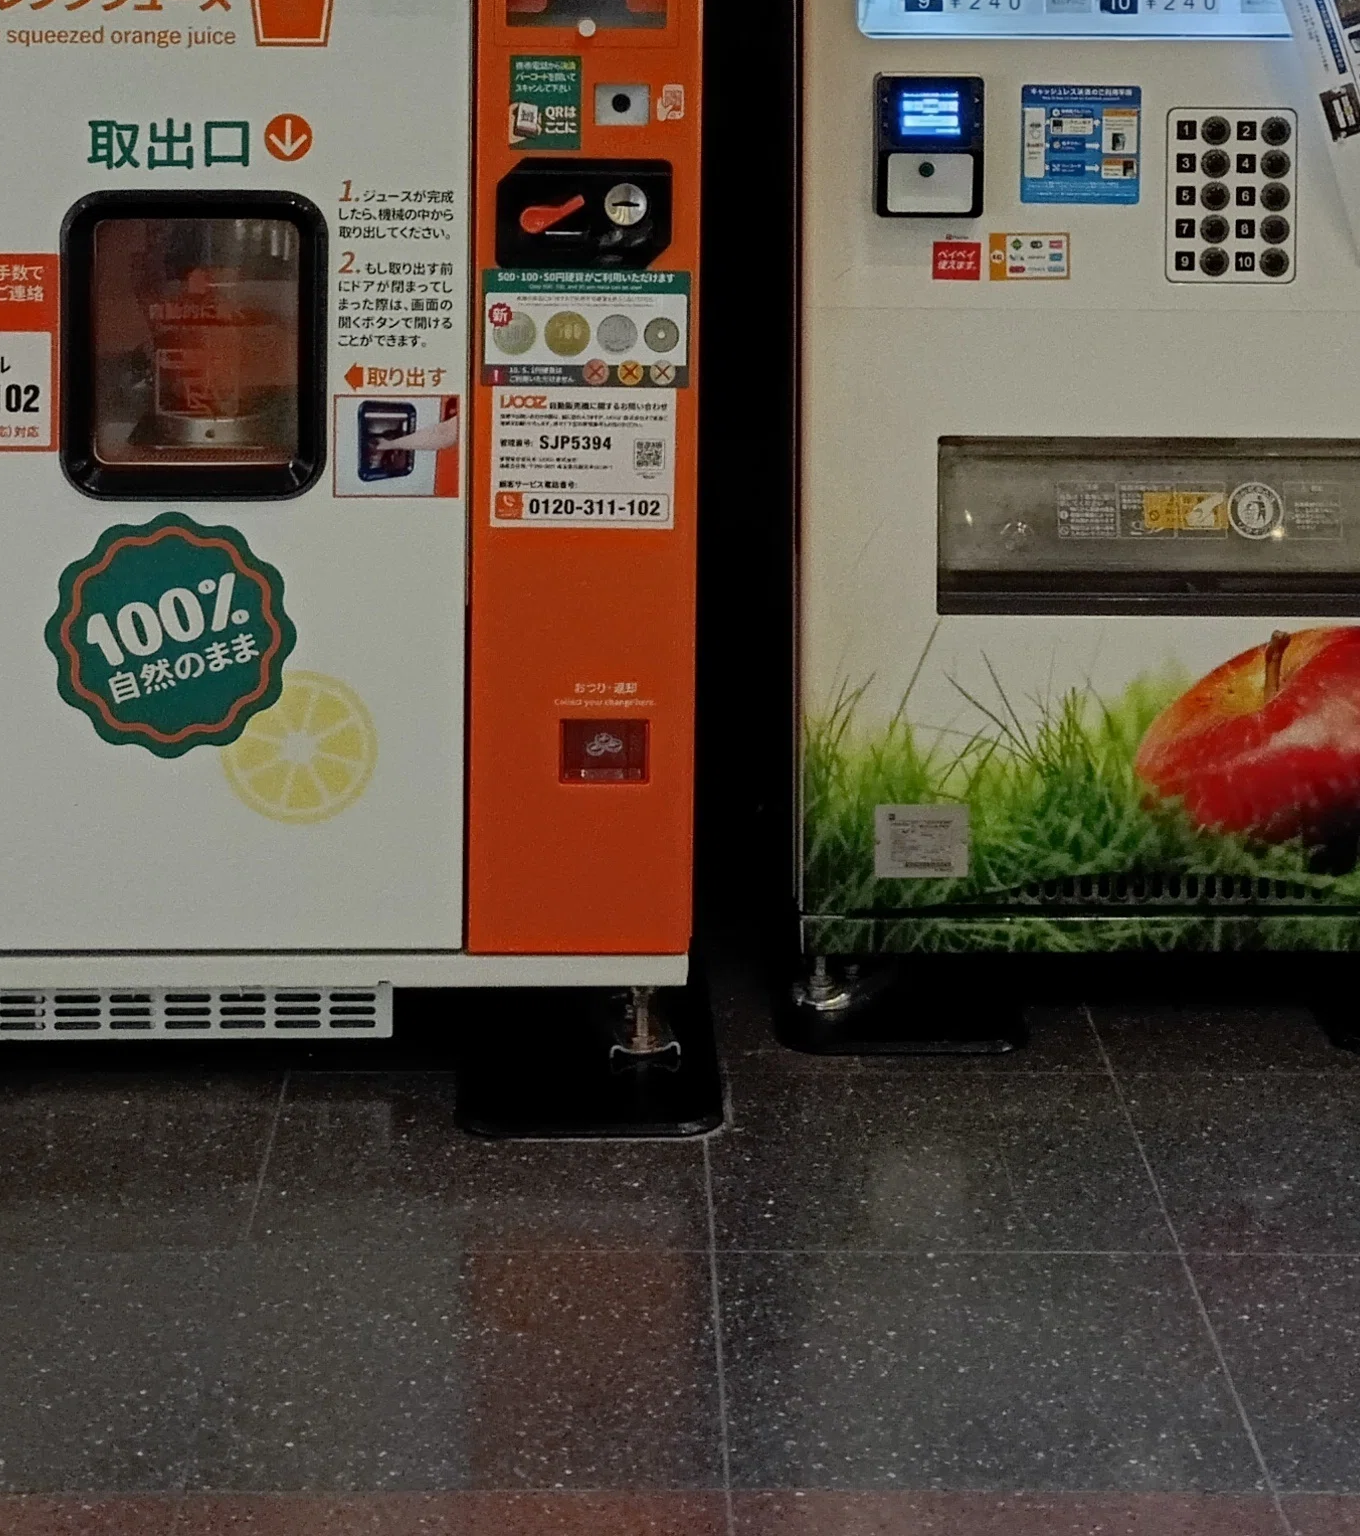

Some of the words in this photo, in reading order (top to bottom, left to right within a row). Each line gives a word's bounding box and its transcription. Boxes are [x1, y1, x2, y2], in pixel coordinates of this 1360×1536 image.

[6, 24, 106, 48] squeezed
[110, 29, 183, 48] orange
[186, 26, 237, 49] juice
[545, 106, 576, 120] QRは
[545, 122, 577, 134] ここに
[1182, 124, 1189, 136] 1
[1242, 125, 1251, 137] 2
[88, 118, 250, 170] 取出口
[1181, 157, 1191, 170] 3
[1241, 157, 1251, 169] 4
[1181, 190, 1190, 202] 5
[1241, 190, 1250, 202] 6
[339, 207, 454, 222] したら、機械の中から
[338, 226, 451, 240] 取り出してください。
[1181, 223, 1190, 235] 7
[1240, 223, 1249, 235] 8
[1180, 255, 1190, 268] 9
[1238, 256, 1253, 268] 10
[338, 279, 453, 293] にドアが閉まってし
[338, 297, 453, 312] まった際は、画面の
[338, 316, 453, 330] 開くボタンで開ける
[338, 334, 429, 348] ことができます。
[366, 367, 447, 389] 取り出す
[540, 435, 612, 450] SJP5394
[529, 499, 660, 516] 0120-311-102
[86, 572, 250, 667] 100%
[107, 633, 260, 704] 自然のまま
